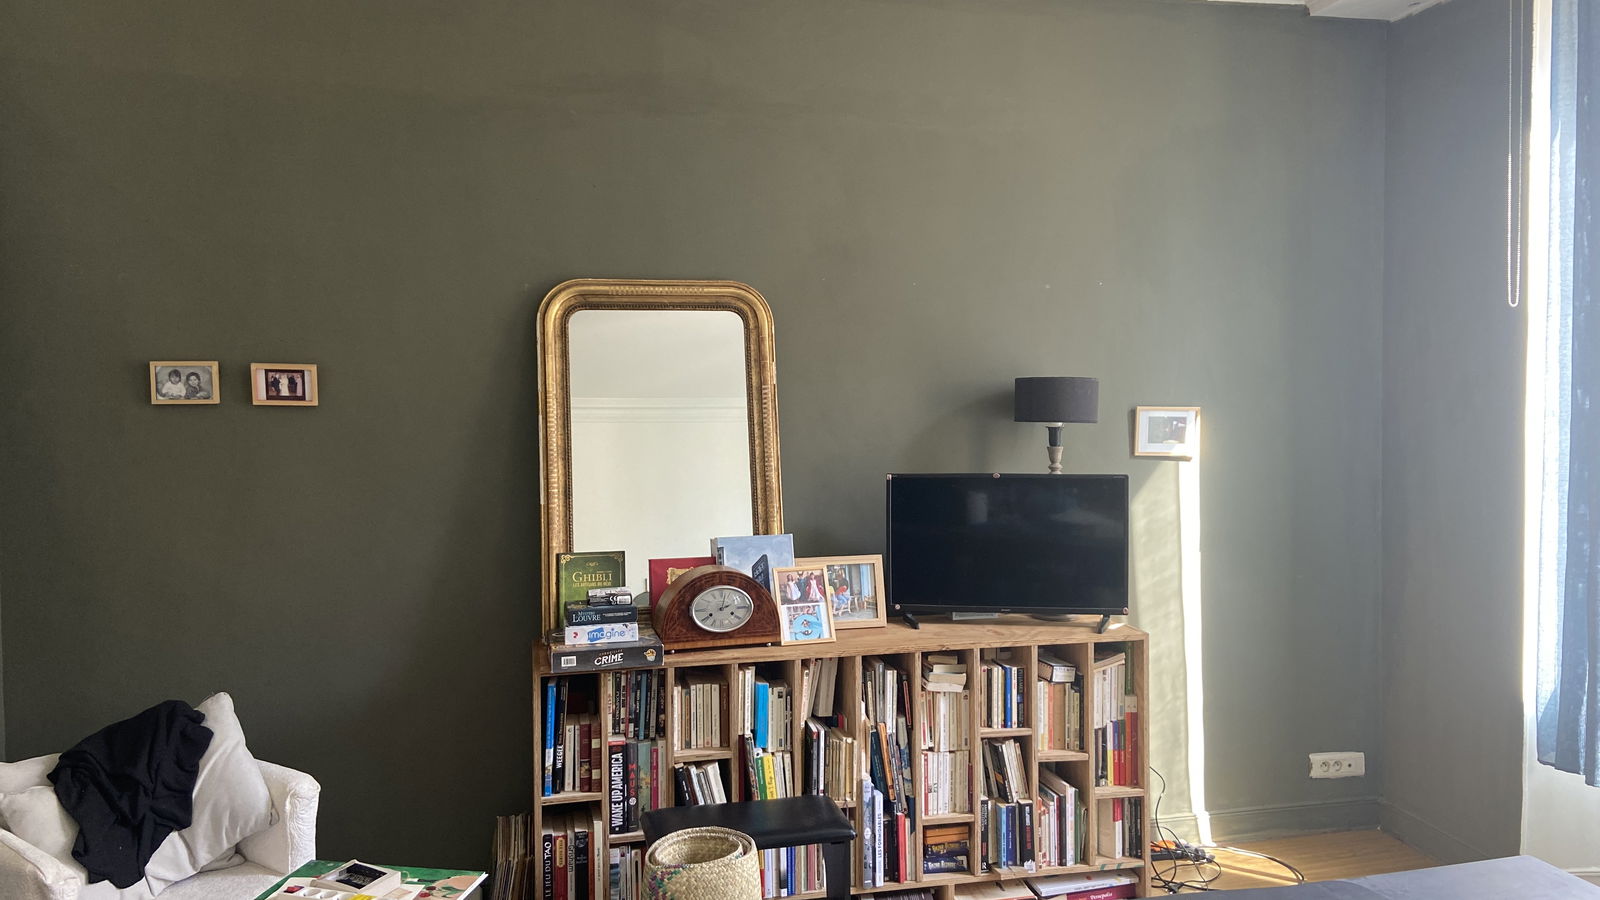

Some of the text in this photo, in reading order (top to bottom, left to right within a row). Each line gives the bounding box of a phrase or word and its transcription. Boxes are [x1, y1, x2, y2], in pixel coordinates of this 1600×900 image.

[572, 571, 612, 583] GHIBLI
[572, 613, 600, 622] LOUVRE
[588, 628, 626, 640] imagine
[594, 652, 624, 666] CRIME
[611, 752, 624, 826] WAKE UP AMERICA
[545, 860, 551, 872] DU
[545, 888, 552, 896] LE
[1090, 892, 1112, 900] Persepolis
